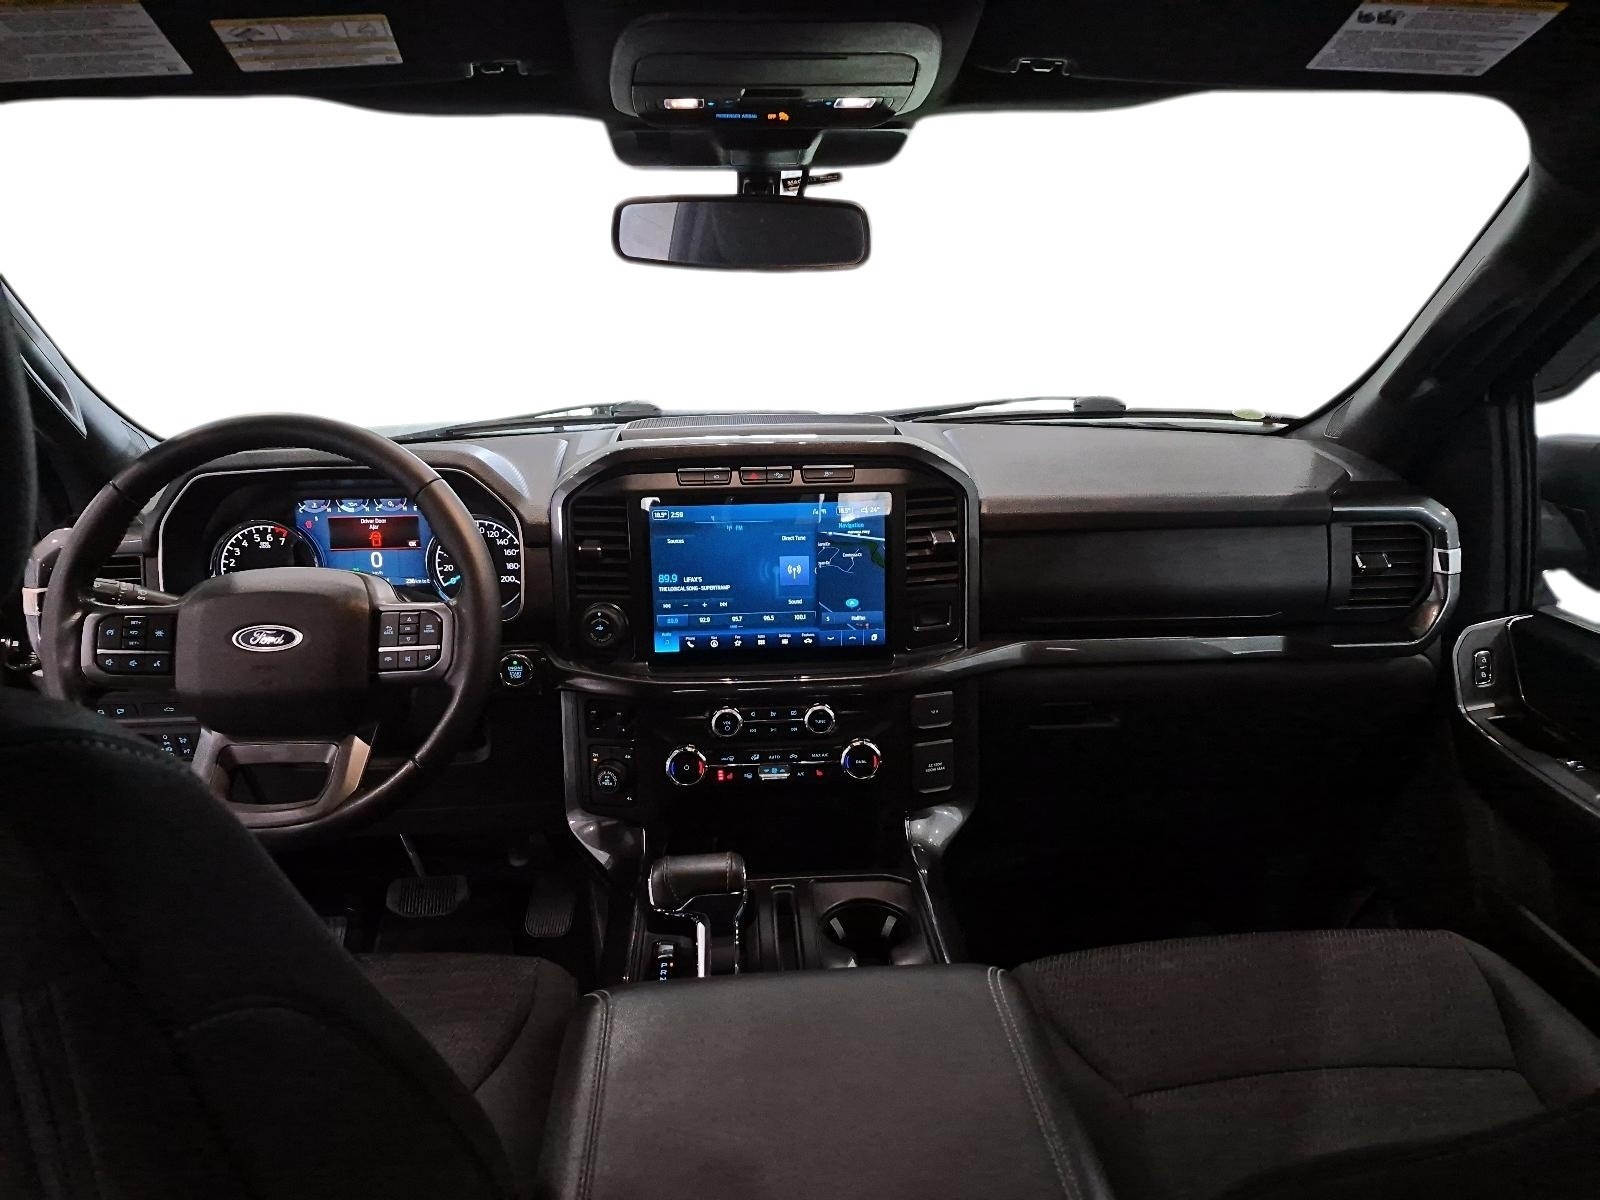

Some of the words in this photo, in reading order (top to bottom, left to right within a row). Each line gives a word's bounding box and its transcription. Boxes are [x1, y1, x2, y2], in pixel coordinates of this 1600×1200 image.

[253, 534, 261, 542] 5
[266, 534, 273, 542] 6
[486, 530, 500, 538] 120
[241, 539, 249, 548] 4
[279, 537, 286, 546] 7
[233, 547, 241, 556] 3
[503, 548, 516, 556] 160
[229, 558, 236, 567] 2
[370, 551, 383, 568] 0
[443, 564, 454, 572] 20
[505, 562, 519, 570] 180
[500, 575, 515, 583] 200
[658, 573, 678, 583] 89.9
[249, 629, 285, 645] Ford
